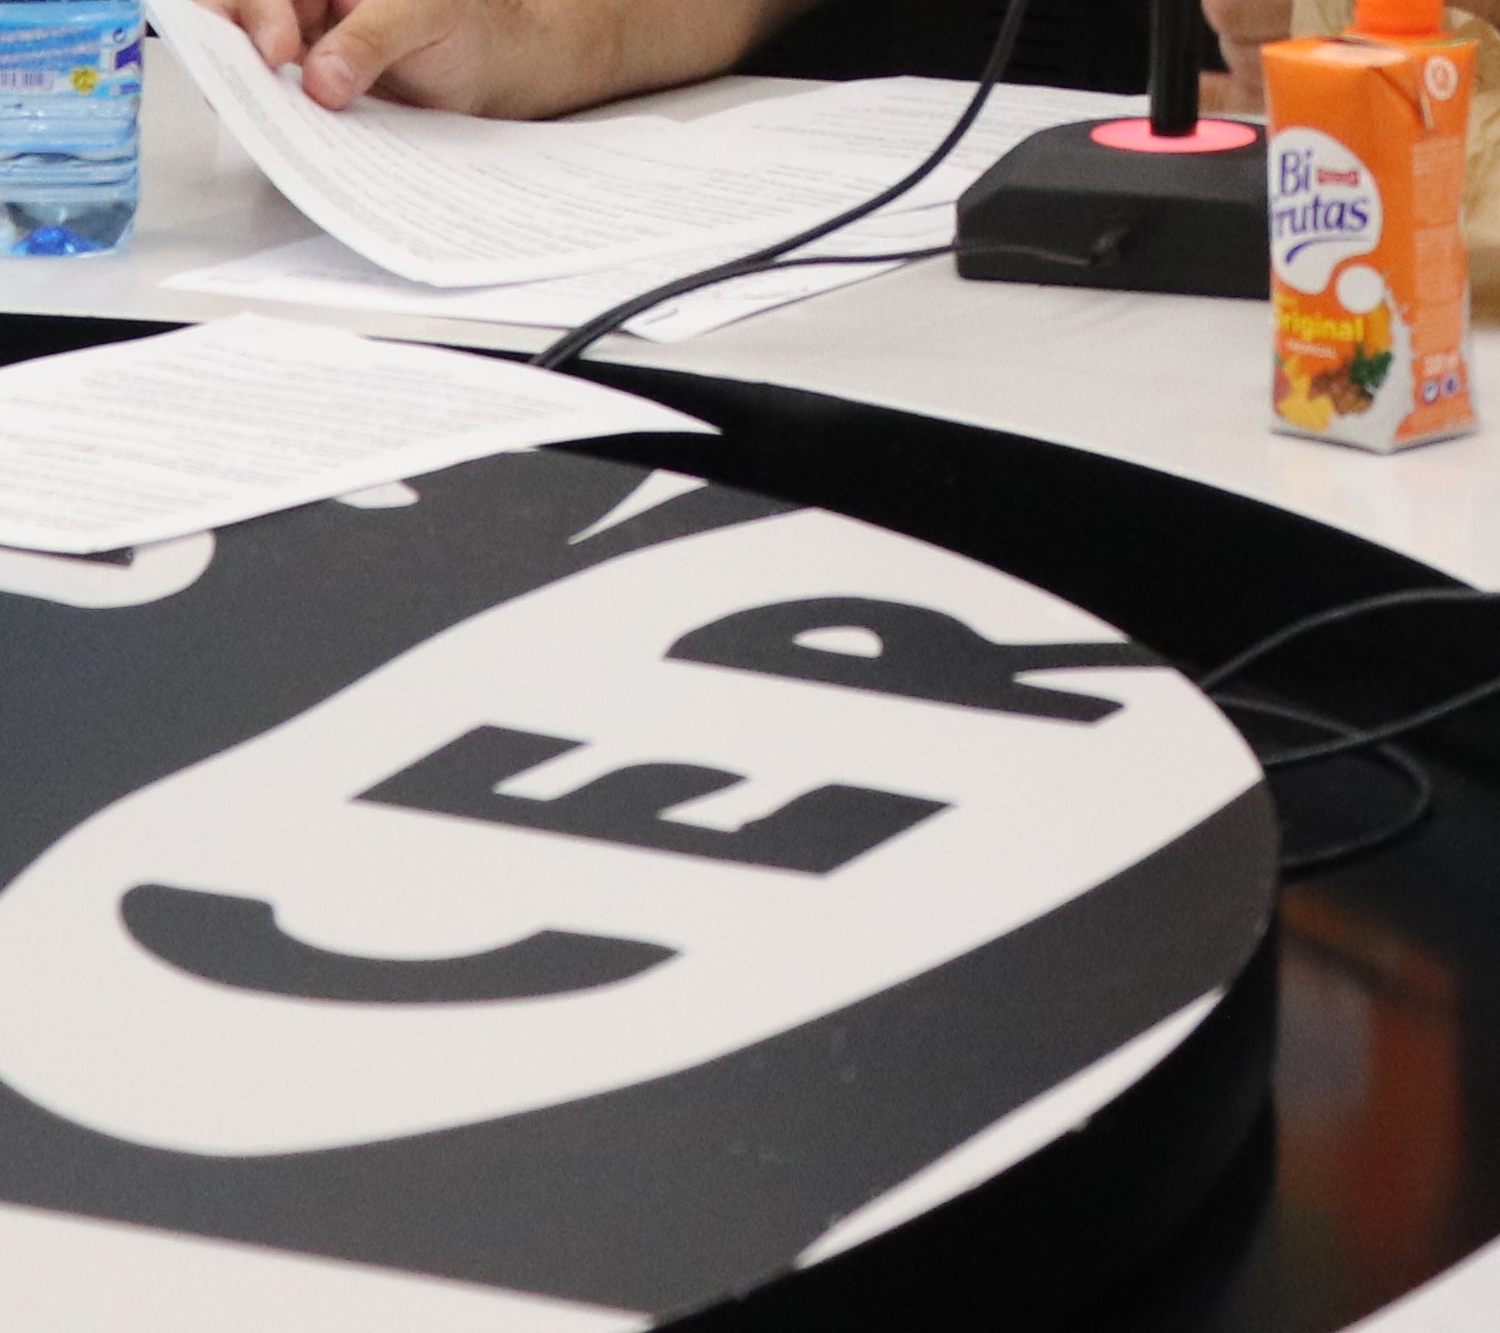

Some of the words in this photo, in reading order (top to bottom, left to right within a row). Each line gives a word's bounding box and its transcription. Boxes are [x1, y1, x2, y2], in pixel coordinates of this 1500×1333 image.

[1281, 149, 1312, 196] Bi
[1272, 195, 1370, 237] rutas
[118, 596, 1165, 1005] CER
